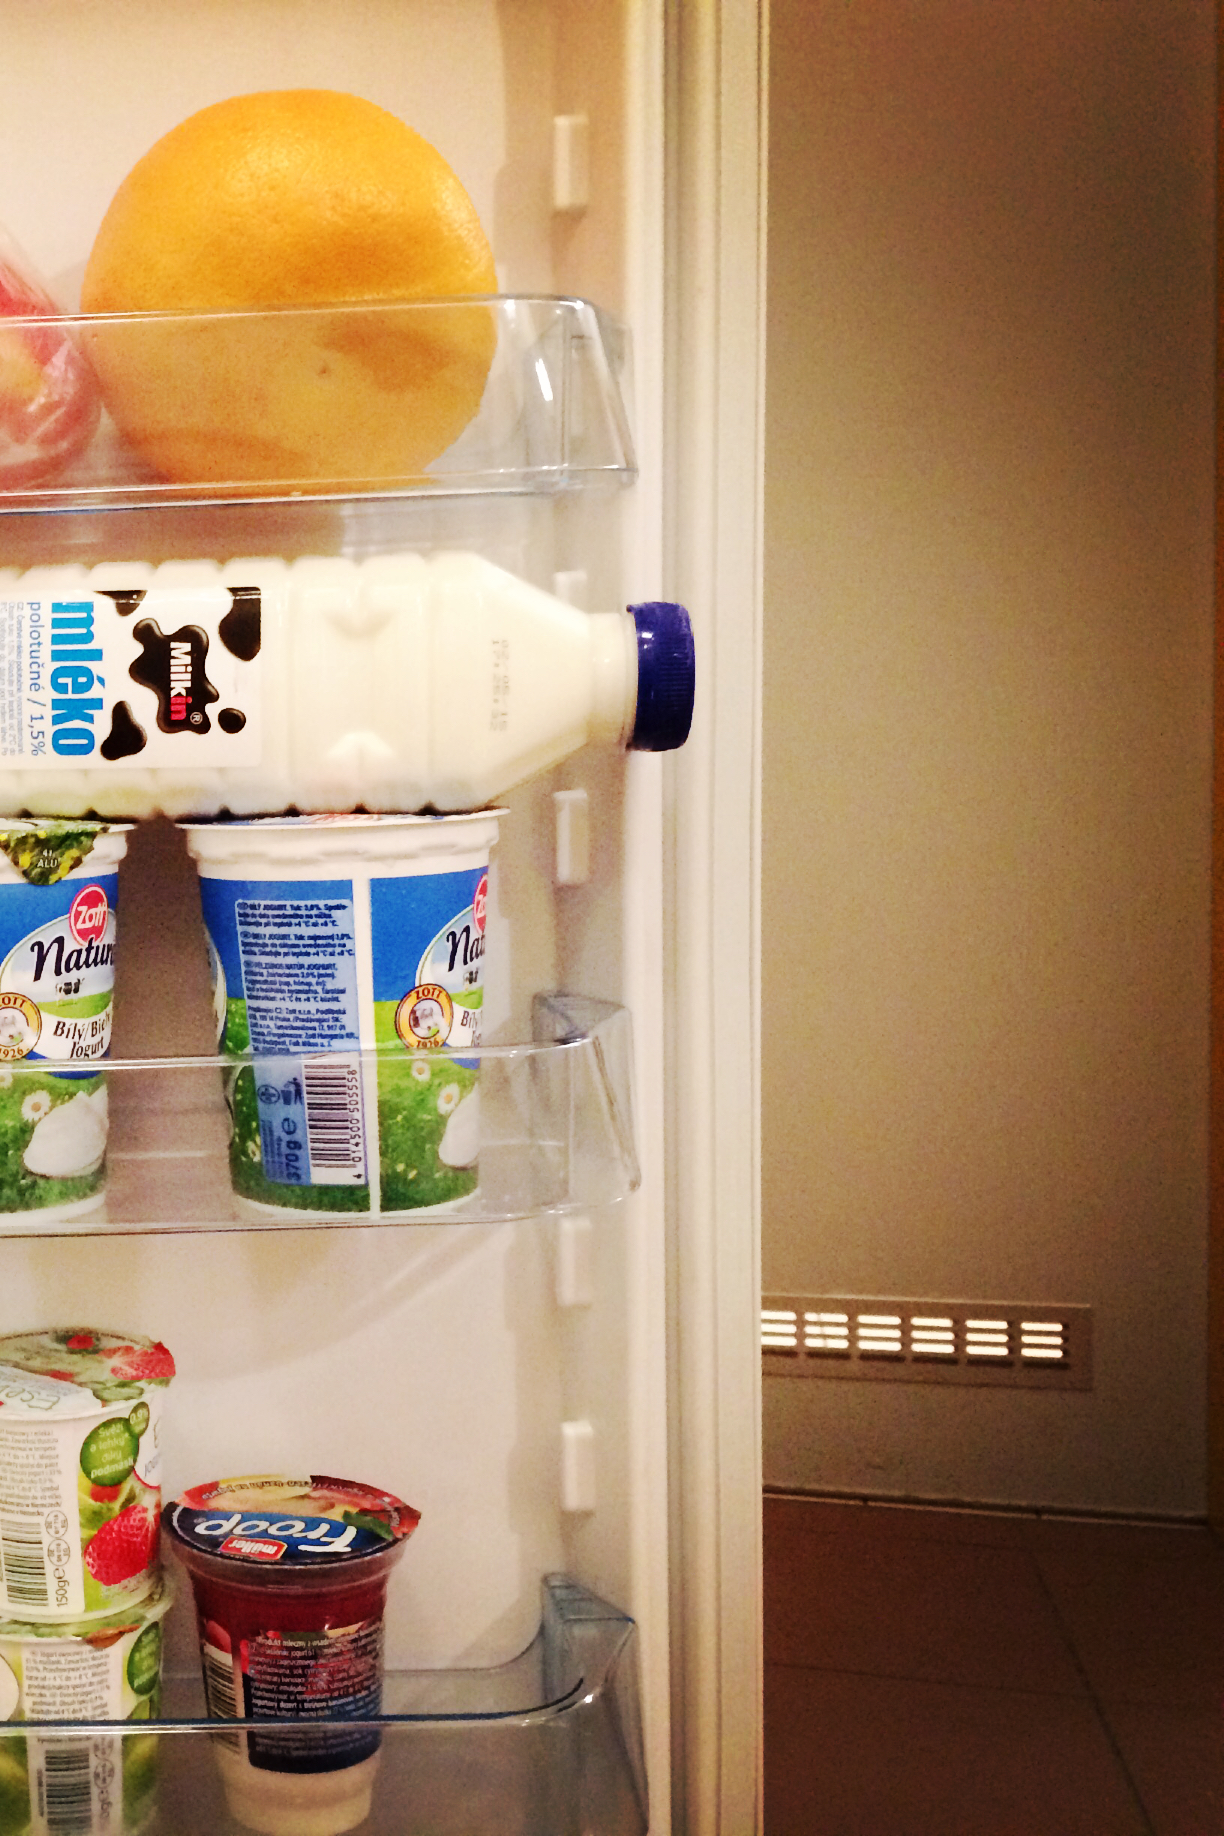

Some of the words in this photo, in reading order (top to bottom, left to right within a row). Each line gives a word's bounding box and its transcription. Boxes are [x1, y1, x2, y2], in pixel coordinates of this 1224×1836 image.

[27, 602, 45, 692] polotučné
[50, 601, 103, 757] mléko
[168, 641, 193, 721] Milkin
[28, 714, 46, 756] 1,5%
[76, 902, 108, 930] Zott
[414, 985, 443, 1000] ZOTT
[194, 1513, 358, 1554] Froop
[228, 1538, 278, 1556] müller
